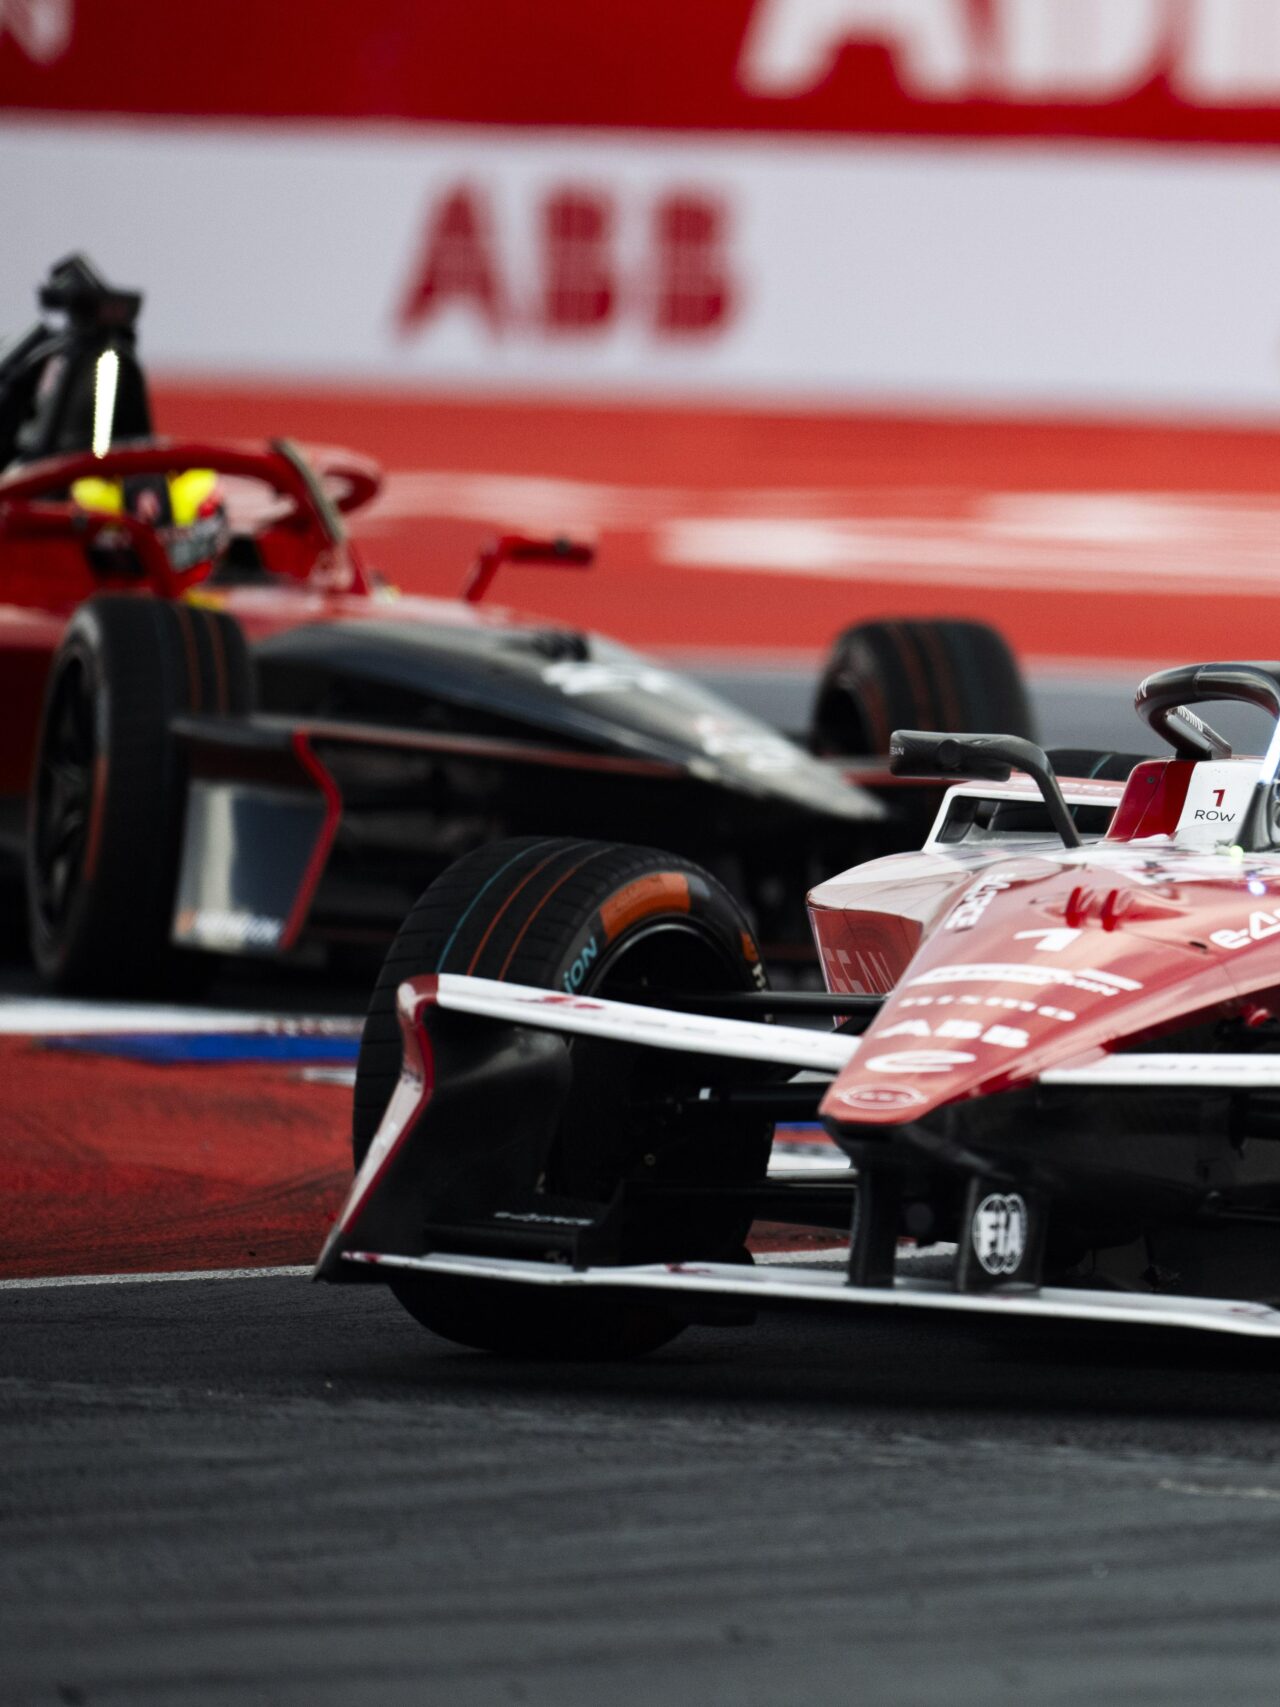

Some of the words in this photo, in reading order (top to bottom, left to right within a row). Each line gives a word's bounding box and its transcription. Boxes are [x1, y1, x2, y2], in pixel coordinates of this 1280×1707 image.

[397, 172, 745, 346] ABB
[1212, 789, 1226, 807] 1
[1194, 808, 1236, 823] ROW
[875, 1018, 1030, 1049] ABB
